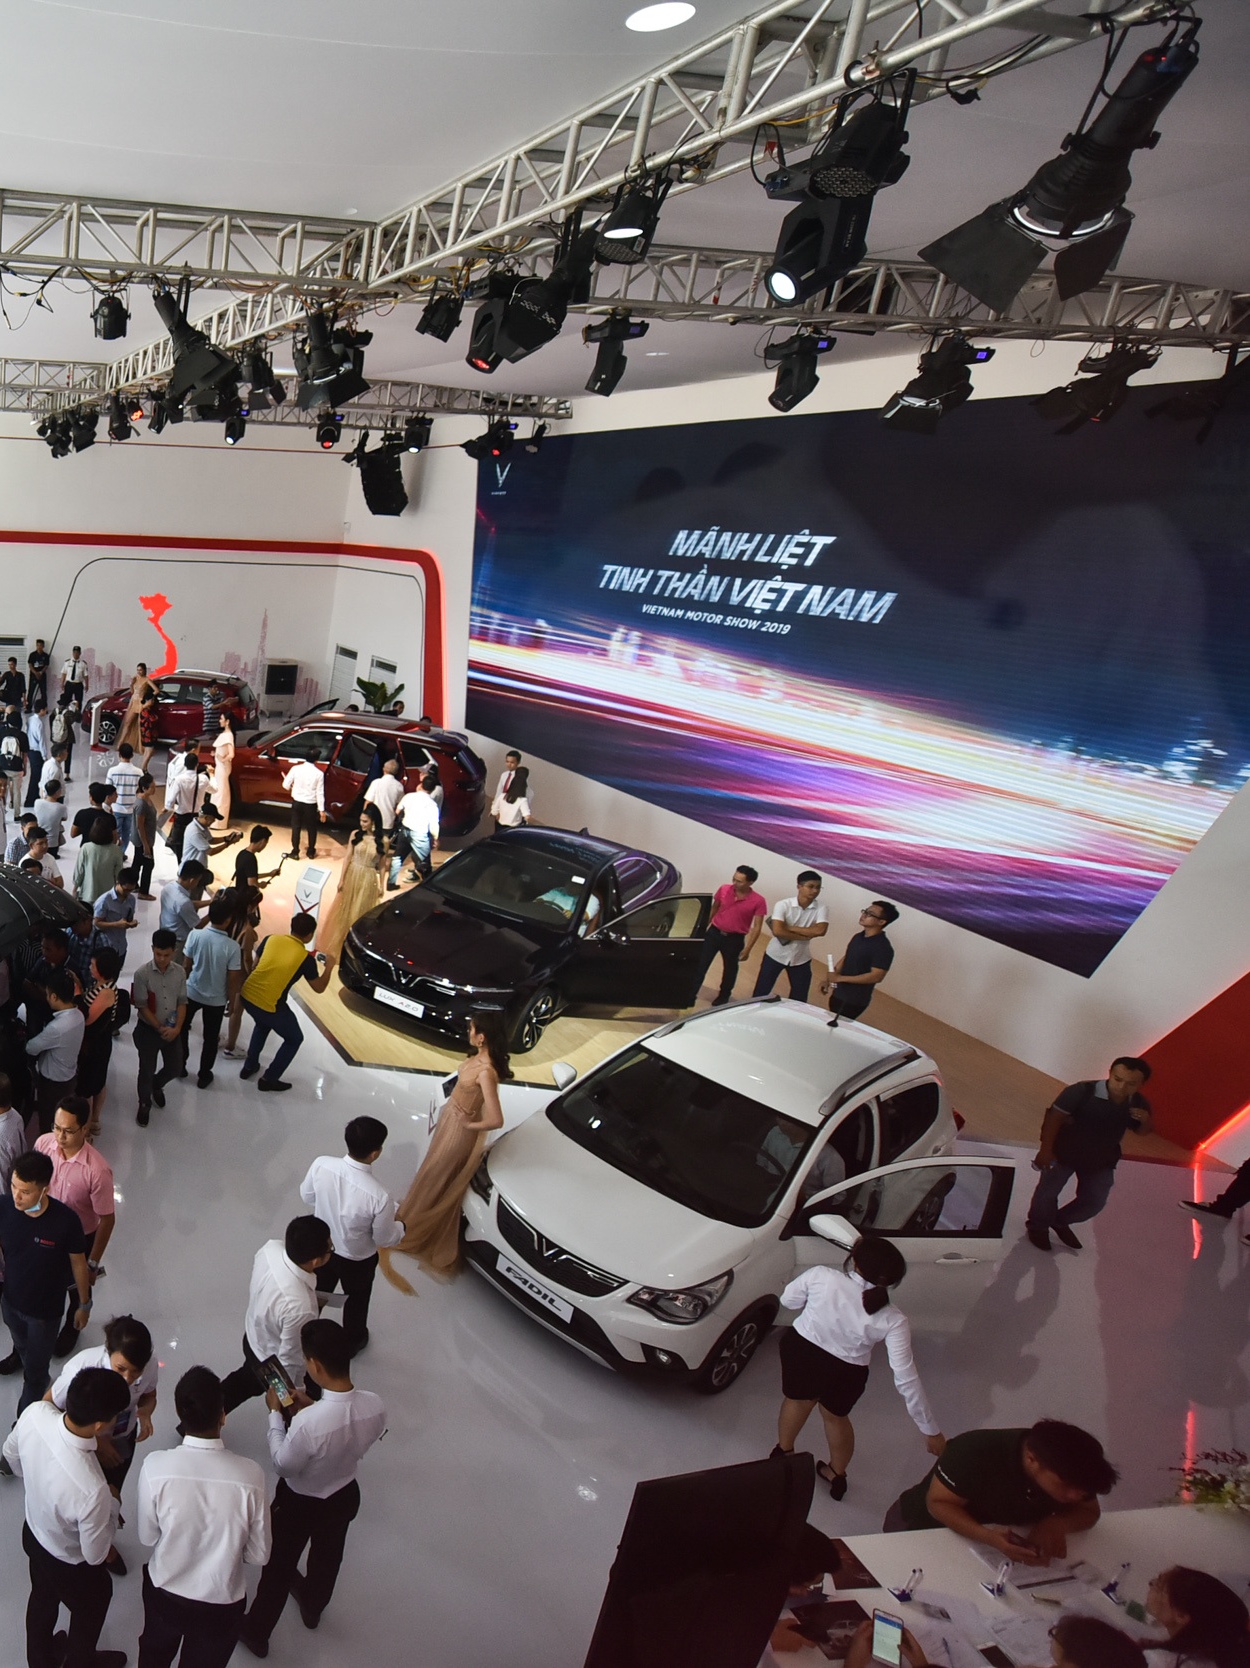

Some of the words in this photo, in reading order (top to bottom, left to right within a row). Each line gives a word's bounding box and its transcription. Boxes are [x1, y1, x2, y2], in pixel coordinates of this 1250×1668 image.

[668, 526, 758, 560] MÃNH
[753, 529, 837, 569] LIỆT
[599, 564, 653, 593] TINH
[651, 564, 729, 603] THẦN
[729, 575, 807, 614] VIỆT
[796, 584, 898, 624] NAM
[641, 603, 684, 619] VIETNAM
[684, 611, 723, 625] MOTOR
[723, 616, 761, 630] SHOW
[760, 622, 791, 635] 2019
[378, 992, 395, 1002] LUX
[505, 1266, 562, 1312] FADIL
